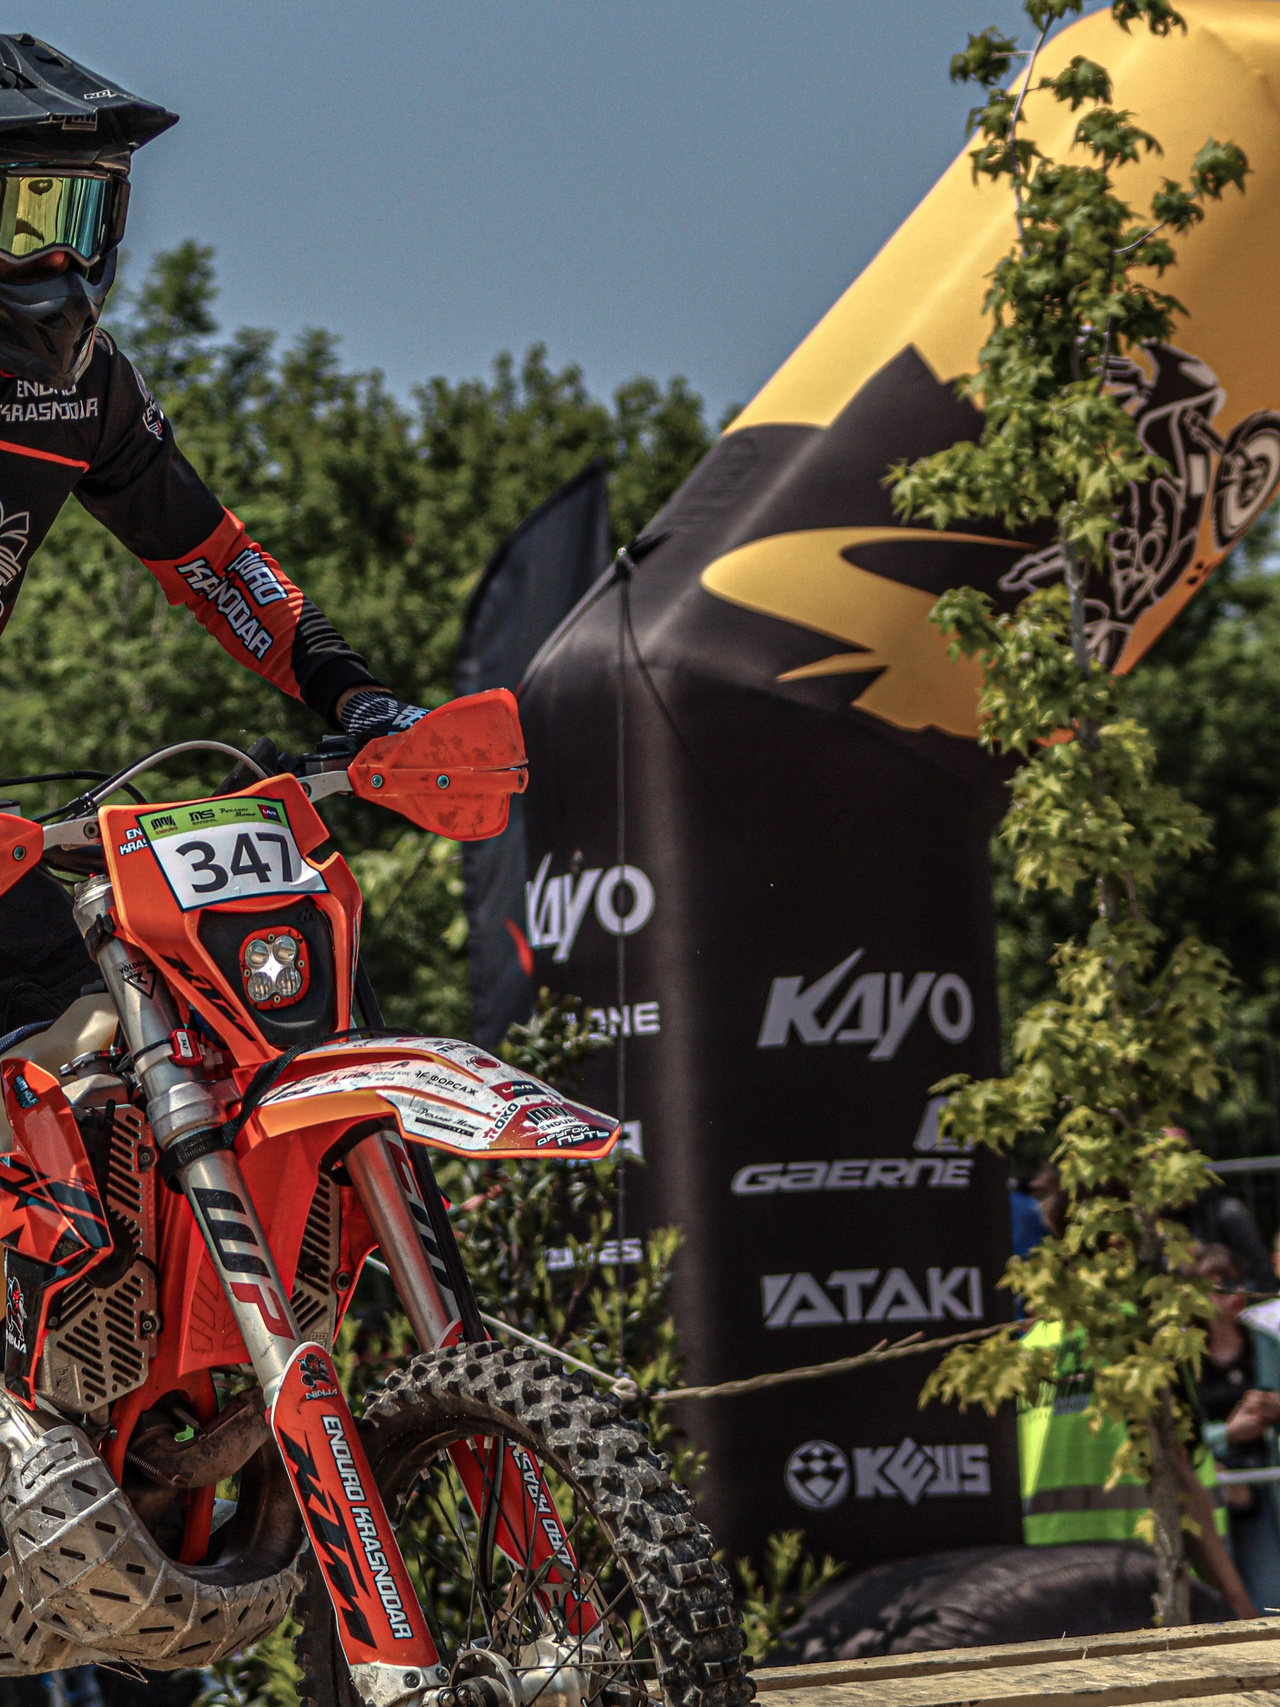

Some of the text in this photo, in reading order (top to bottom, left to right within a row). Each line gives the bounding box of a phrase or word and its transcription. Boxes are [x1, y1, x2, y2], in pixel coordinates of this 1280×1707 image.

[155, 826, 179, 836] ENDURO
[175, 832, 294, 894] 347
[757, 948, 975, 1061] KAYO
[430, 1075, 479, 1096] ФОРСАЖ
[760, 1267, 984, 1329] ATAKI
[320, 1414, 413, 1640] ENDURO KRASNODAR
